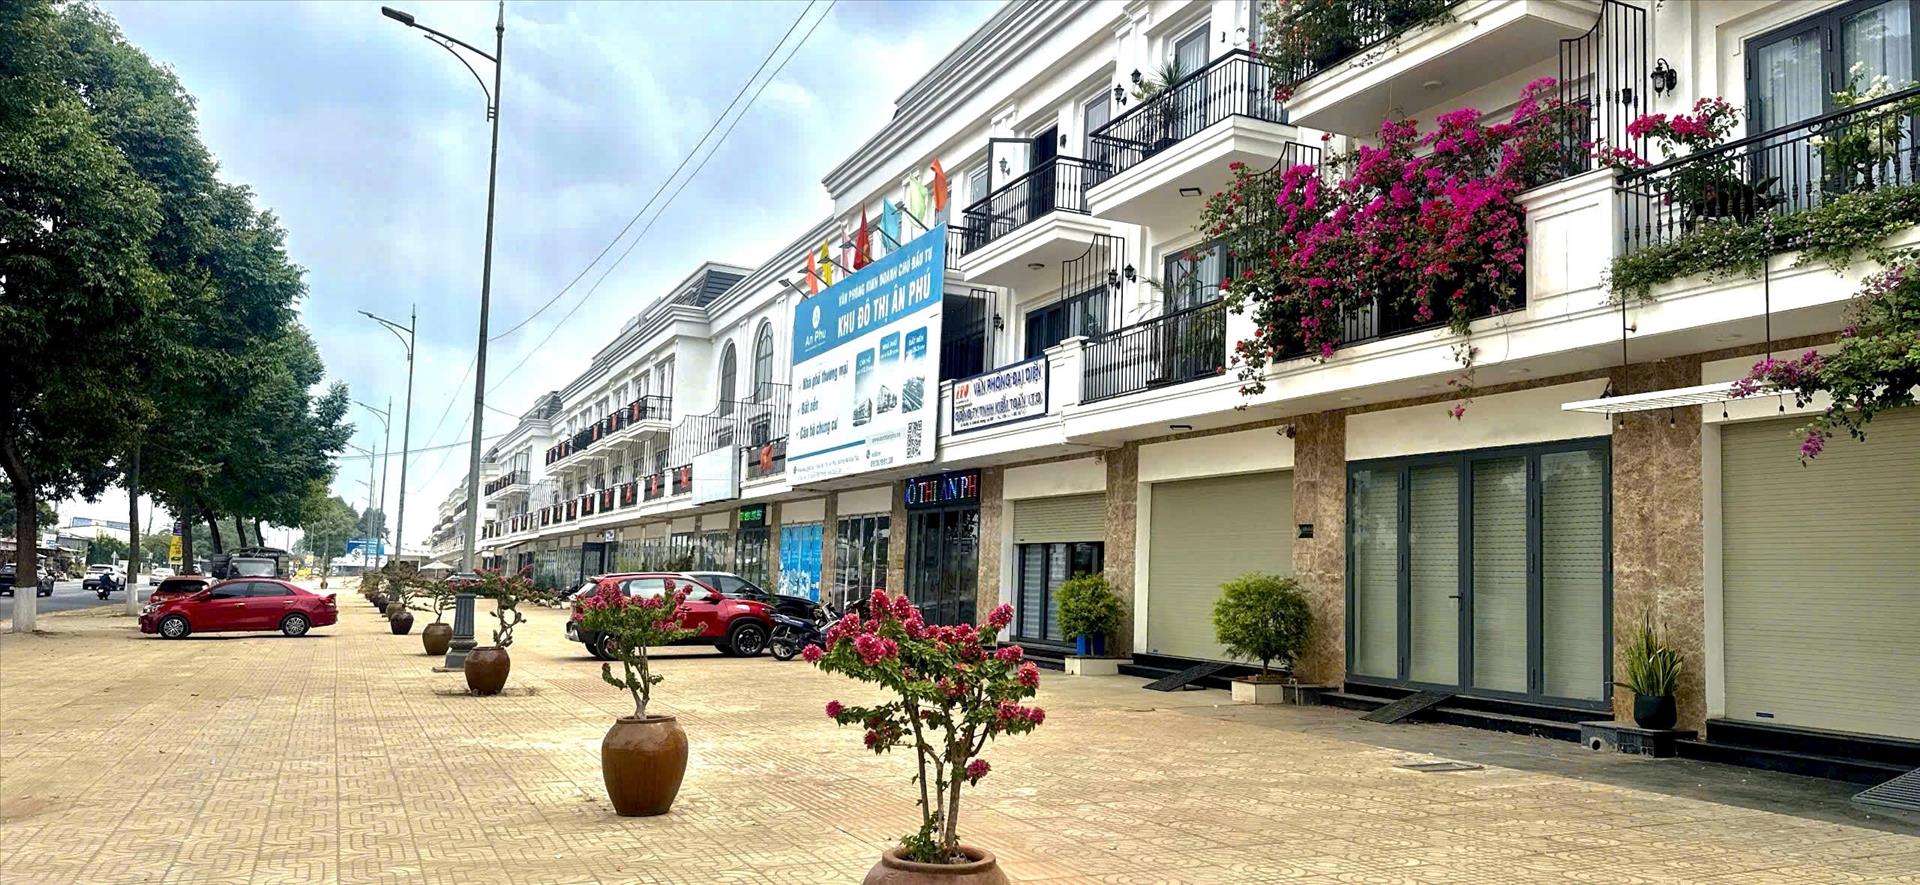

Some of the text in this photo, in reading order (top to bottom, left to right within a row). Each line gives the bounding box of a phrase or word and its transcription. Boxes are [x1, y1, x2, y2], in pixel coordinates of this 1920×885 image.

[879, 266, 898, 287] DOANH
[837, 311, 856, 339] KHU
[857, 297, 871, 330] ĐÔ
[873, 294, 890, 323] THỊ
[908, 267, 931, 307] PHÚ
[973, 378, 987, 397] VĂN
[987, 370, 1012, 392] PHÒNG
[1012, 368, 1025, 390] ĐẠI
[979, 403, 995, 418] TNHH
[816, 420, 831, 436] chung
